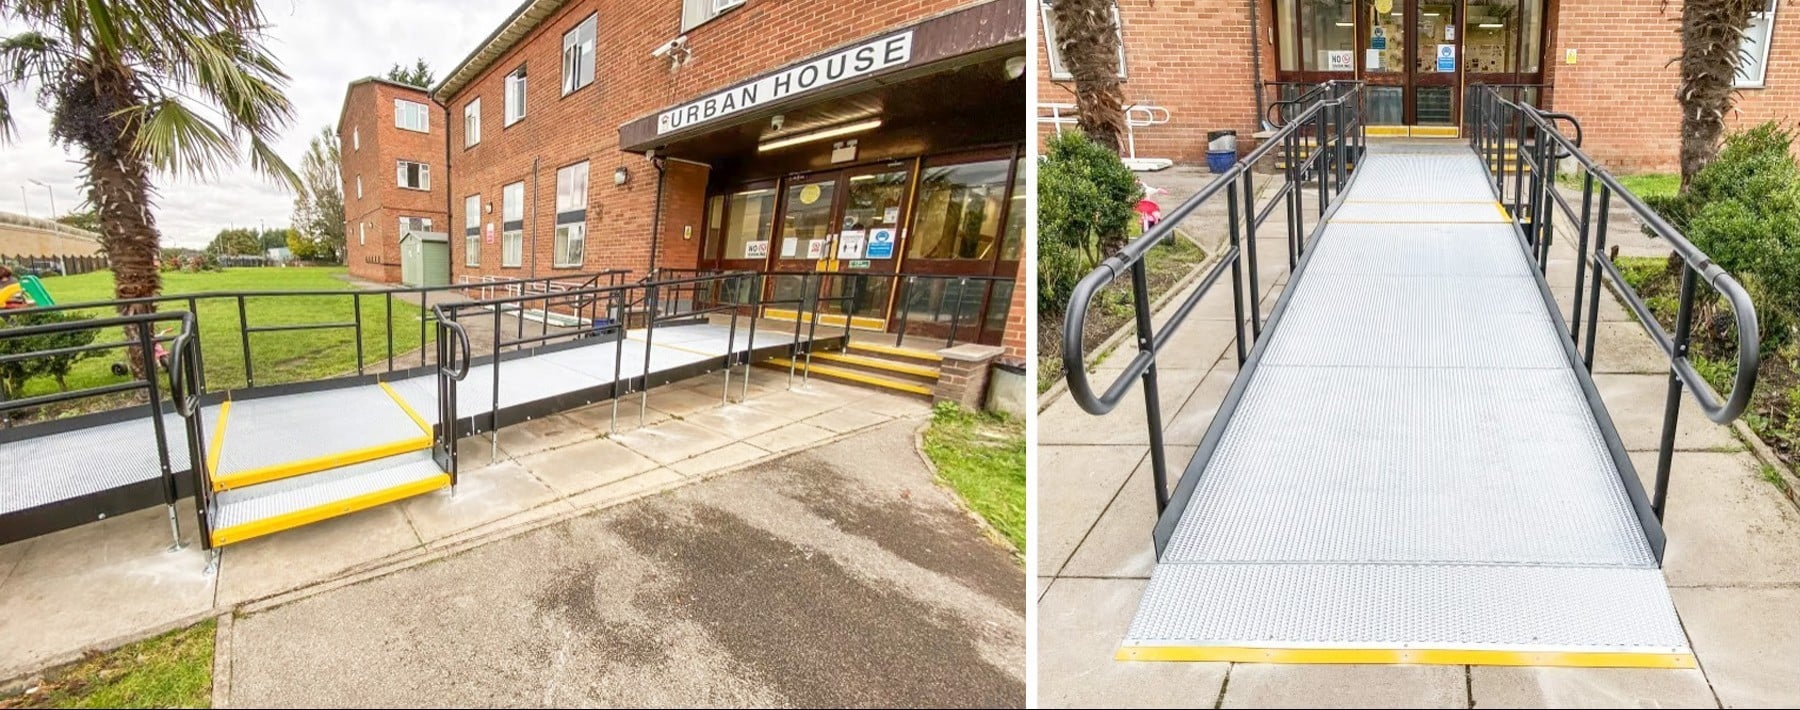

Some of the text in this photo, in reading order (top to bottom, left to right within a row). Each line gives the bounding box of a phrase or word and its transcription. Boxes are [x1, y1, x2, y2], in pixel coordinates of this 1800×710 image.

[671, 35, 906, 128] URBAN HOUSE
[1332, 55, 1341, 64] NO
